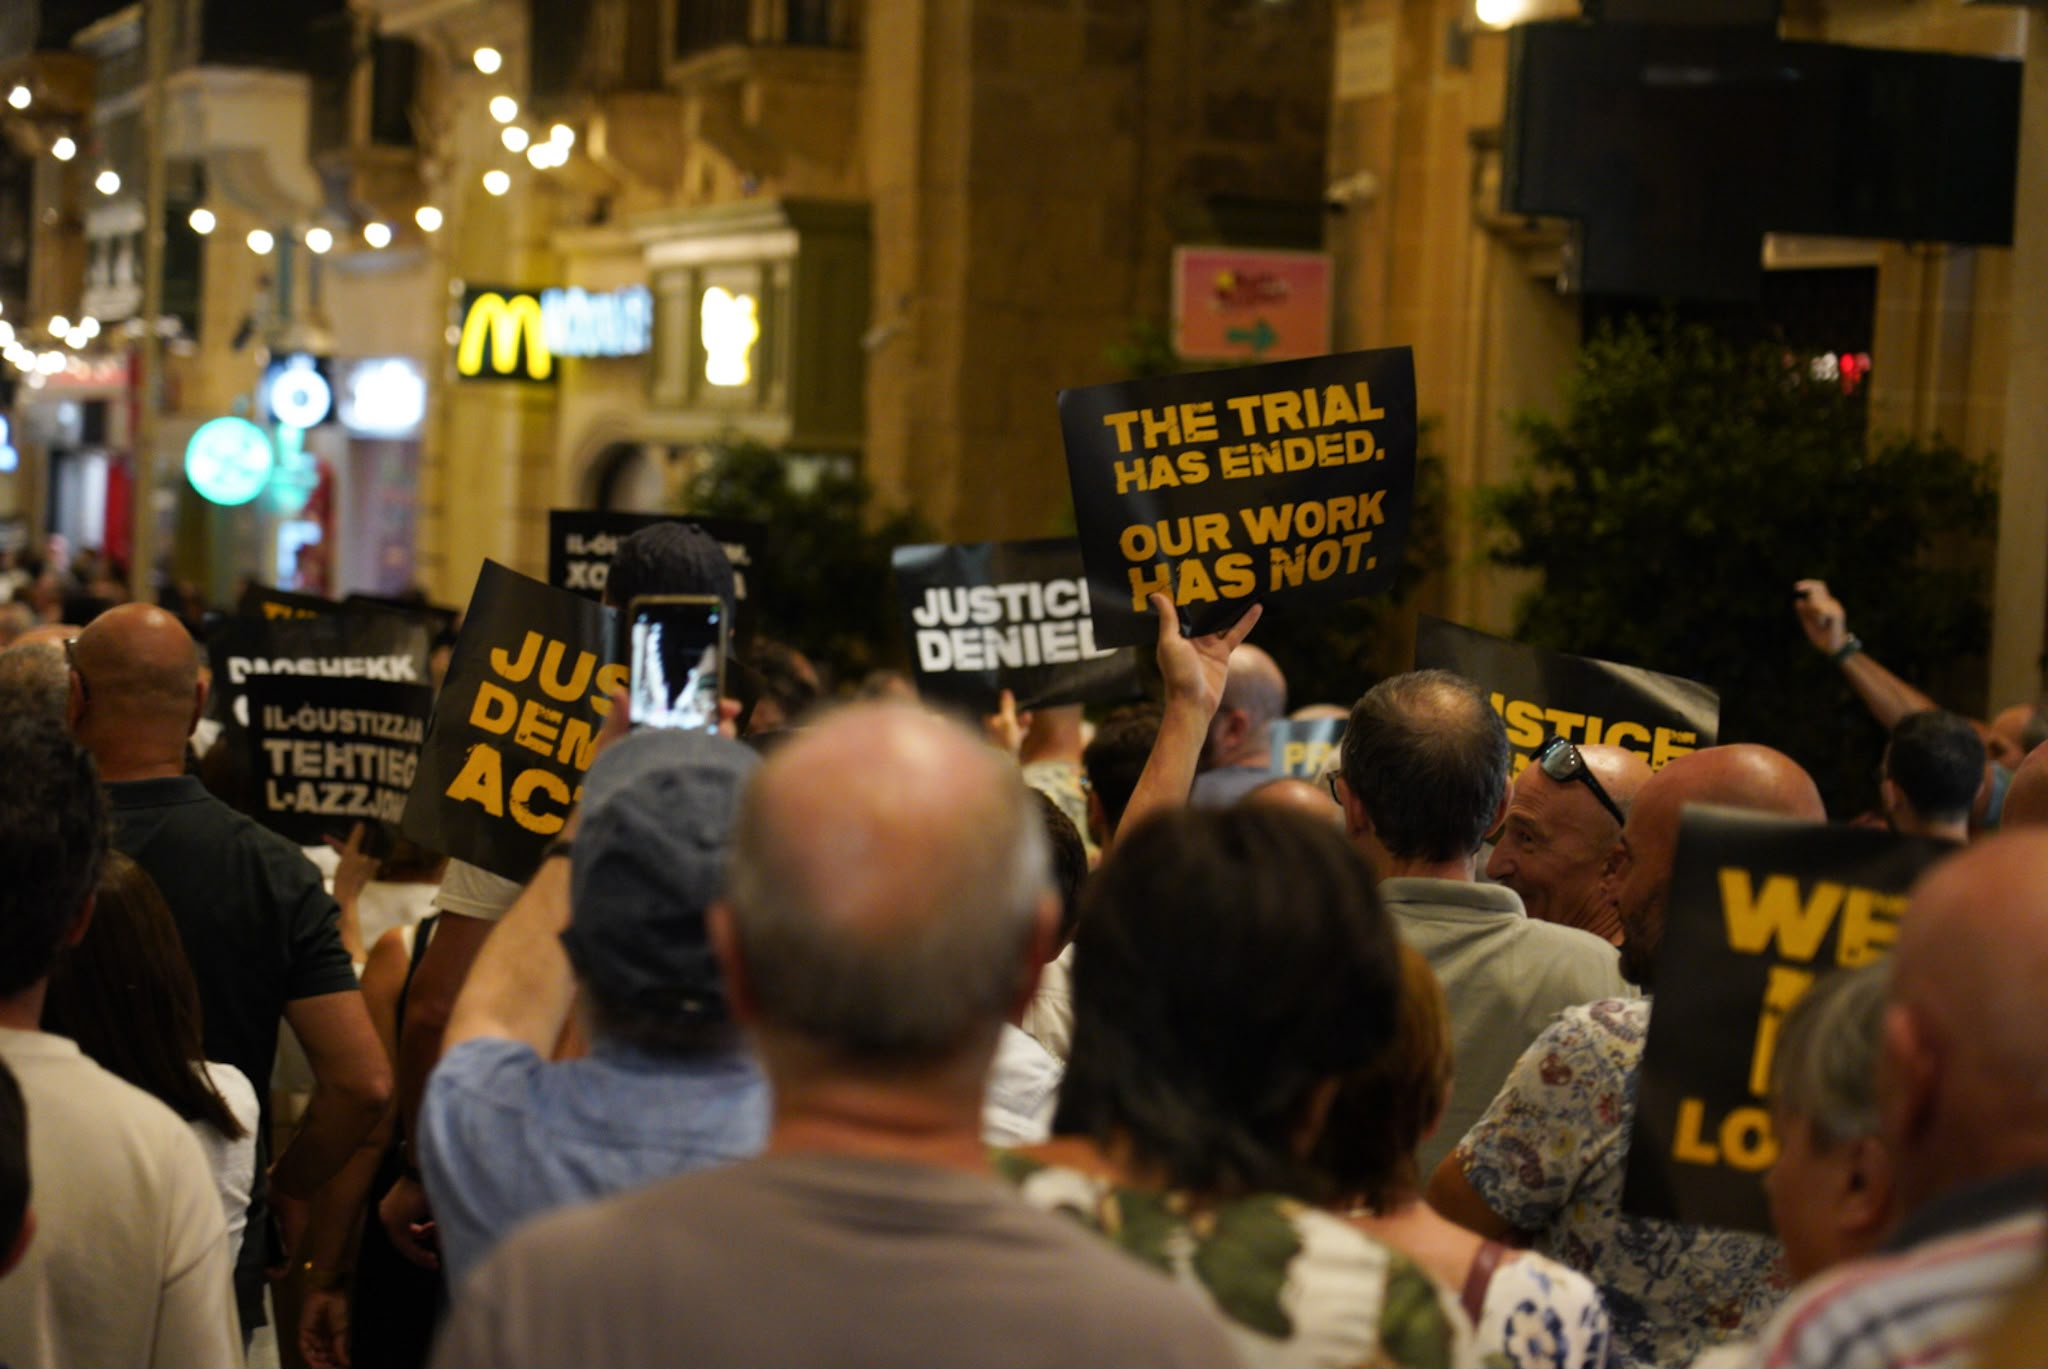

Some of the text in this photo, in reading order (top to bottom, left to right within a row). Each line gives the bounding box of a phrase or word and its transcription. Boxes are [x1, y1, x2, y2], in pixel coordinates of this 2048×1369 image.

[1103, 381, 1385, 453] THE TRIAL
[1114, 429, 1385, 494] HAS ENDED.
[1119, 490, 1388, 562] OUR WORK
[1128, 531, 1378, 613] HAS NOT.
[1490, 692, 1697, 773] STICE
[445, 743, 583, 835] AC
[1717, 866, 1909, 968] WE
